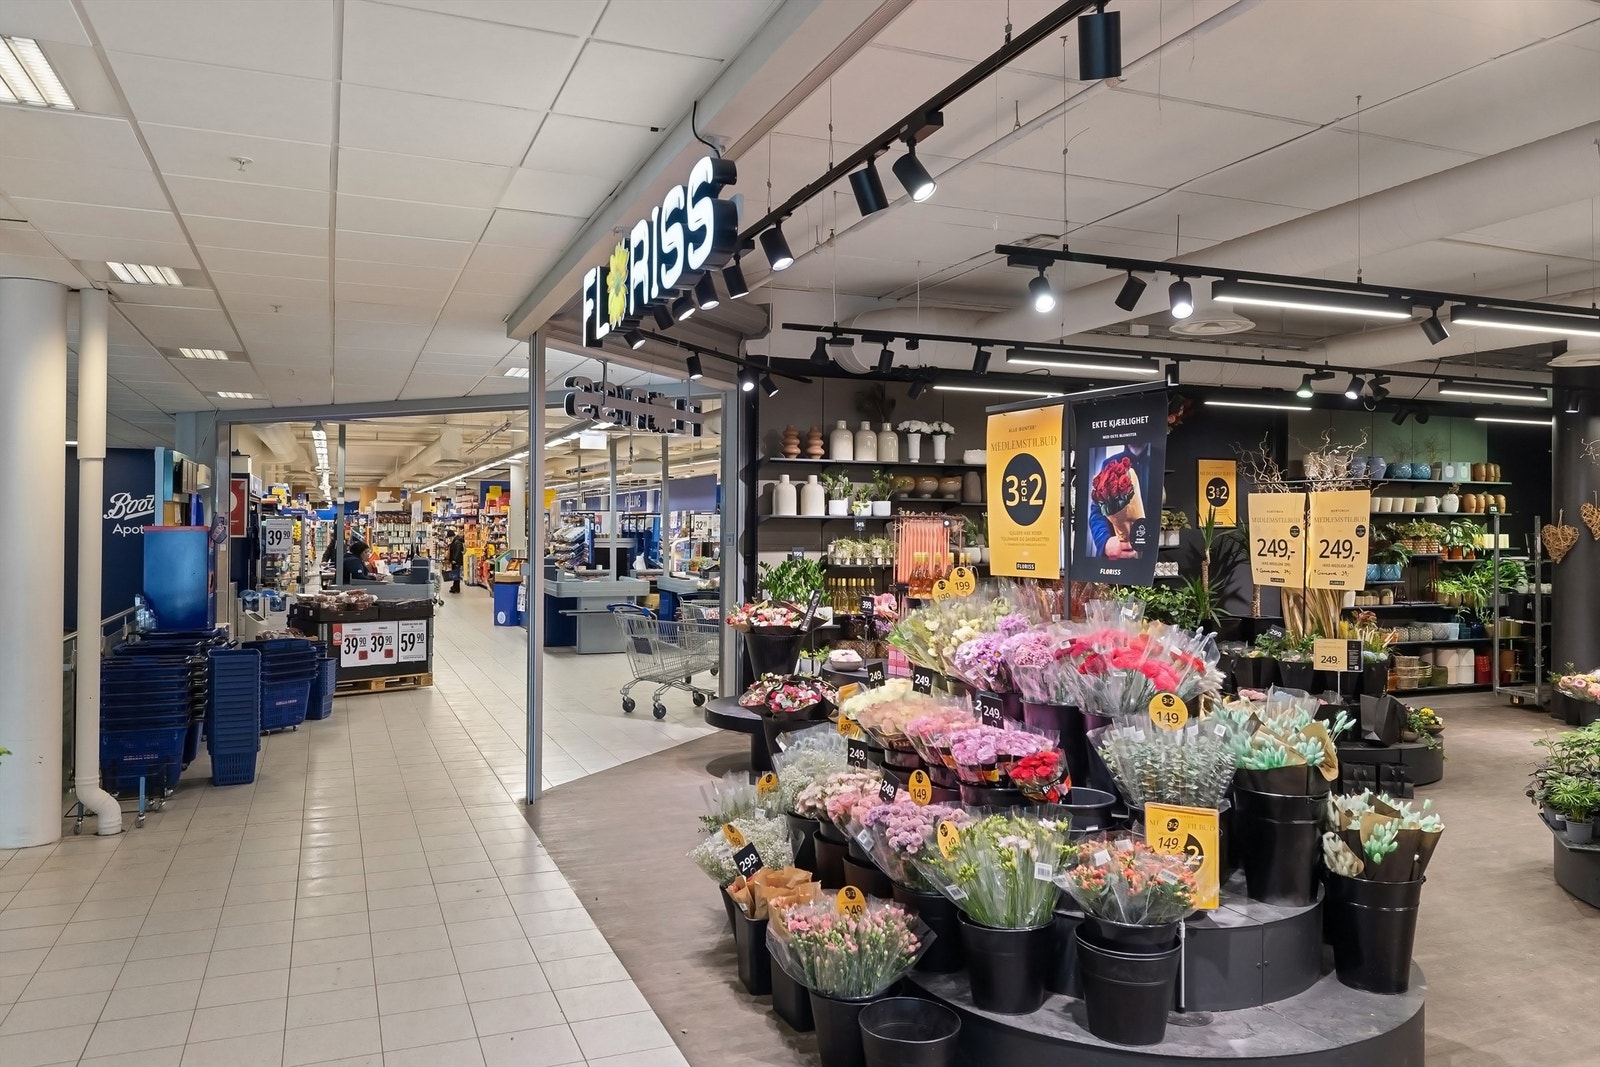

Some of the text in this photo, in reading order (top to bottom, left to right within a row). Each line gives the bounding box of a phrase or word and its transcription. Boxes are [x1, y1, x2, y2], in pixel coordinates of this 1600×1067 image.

[1092, 416, 1149, 429] EKTE KJÆRLIGHET
[991, 436, 1057, 452] MEDLEMSTILBUD
[1006, 475, 1020, 506] 3
[1029, 473, 1043, 506] 2
[1208, 486, 1216, 499] 3
[1220, 486, 1228, 499] 2
[103, 492, 155, 520] Boot
[112, 523, 144, 537] Apot
[1257, 538, 1295, 560] 249,-
[1319, 539, 1360, 562] 249,-
[344, 637, 358, 655] 39
[371, 635, 384, 653] 39
[401, 633, 415, 652] 59
